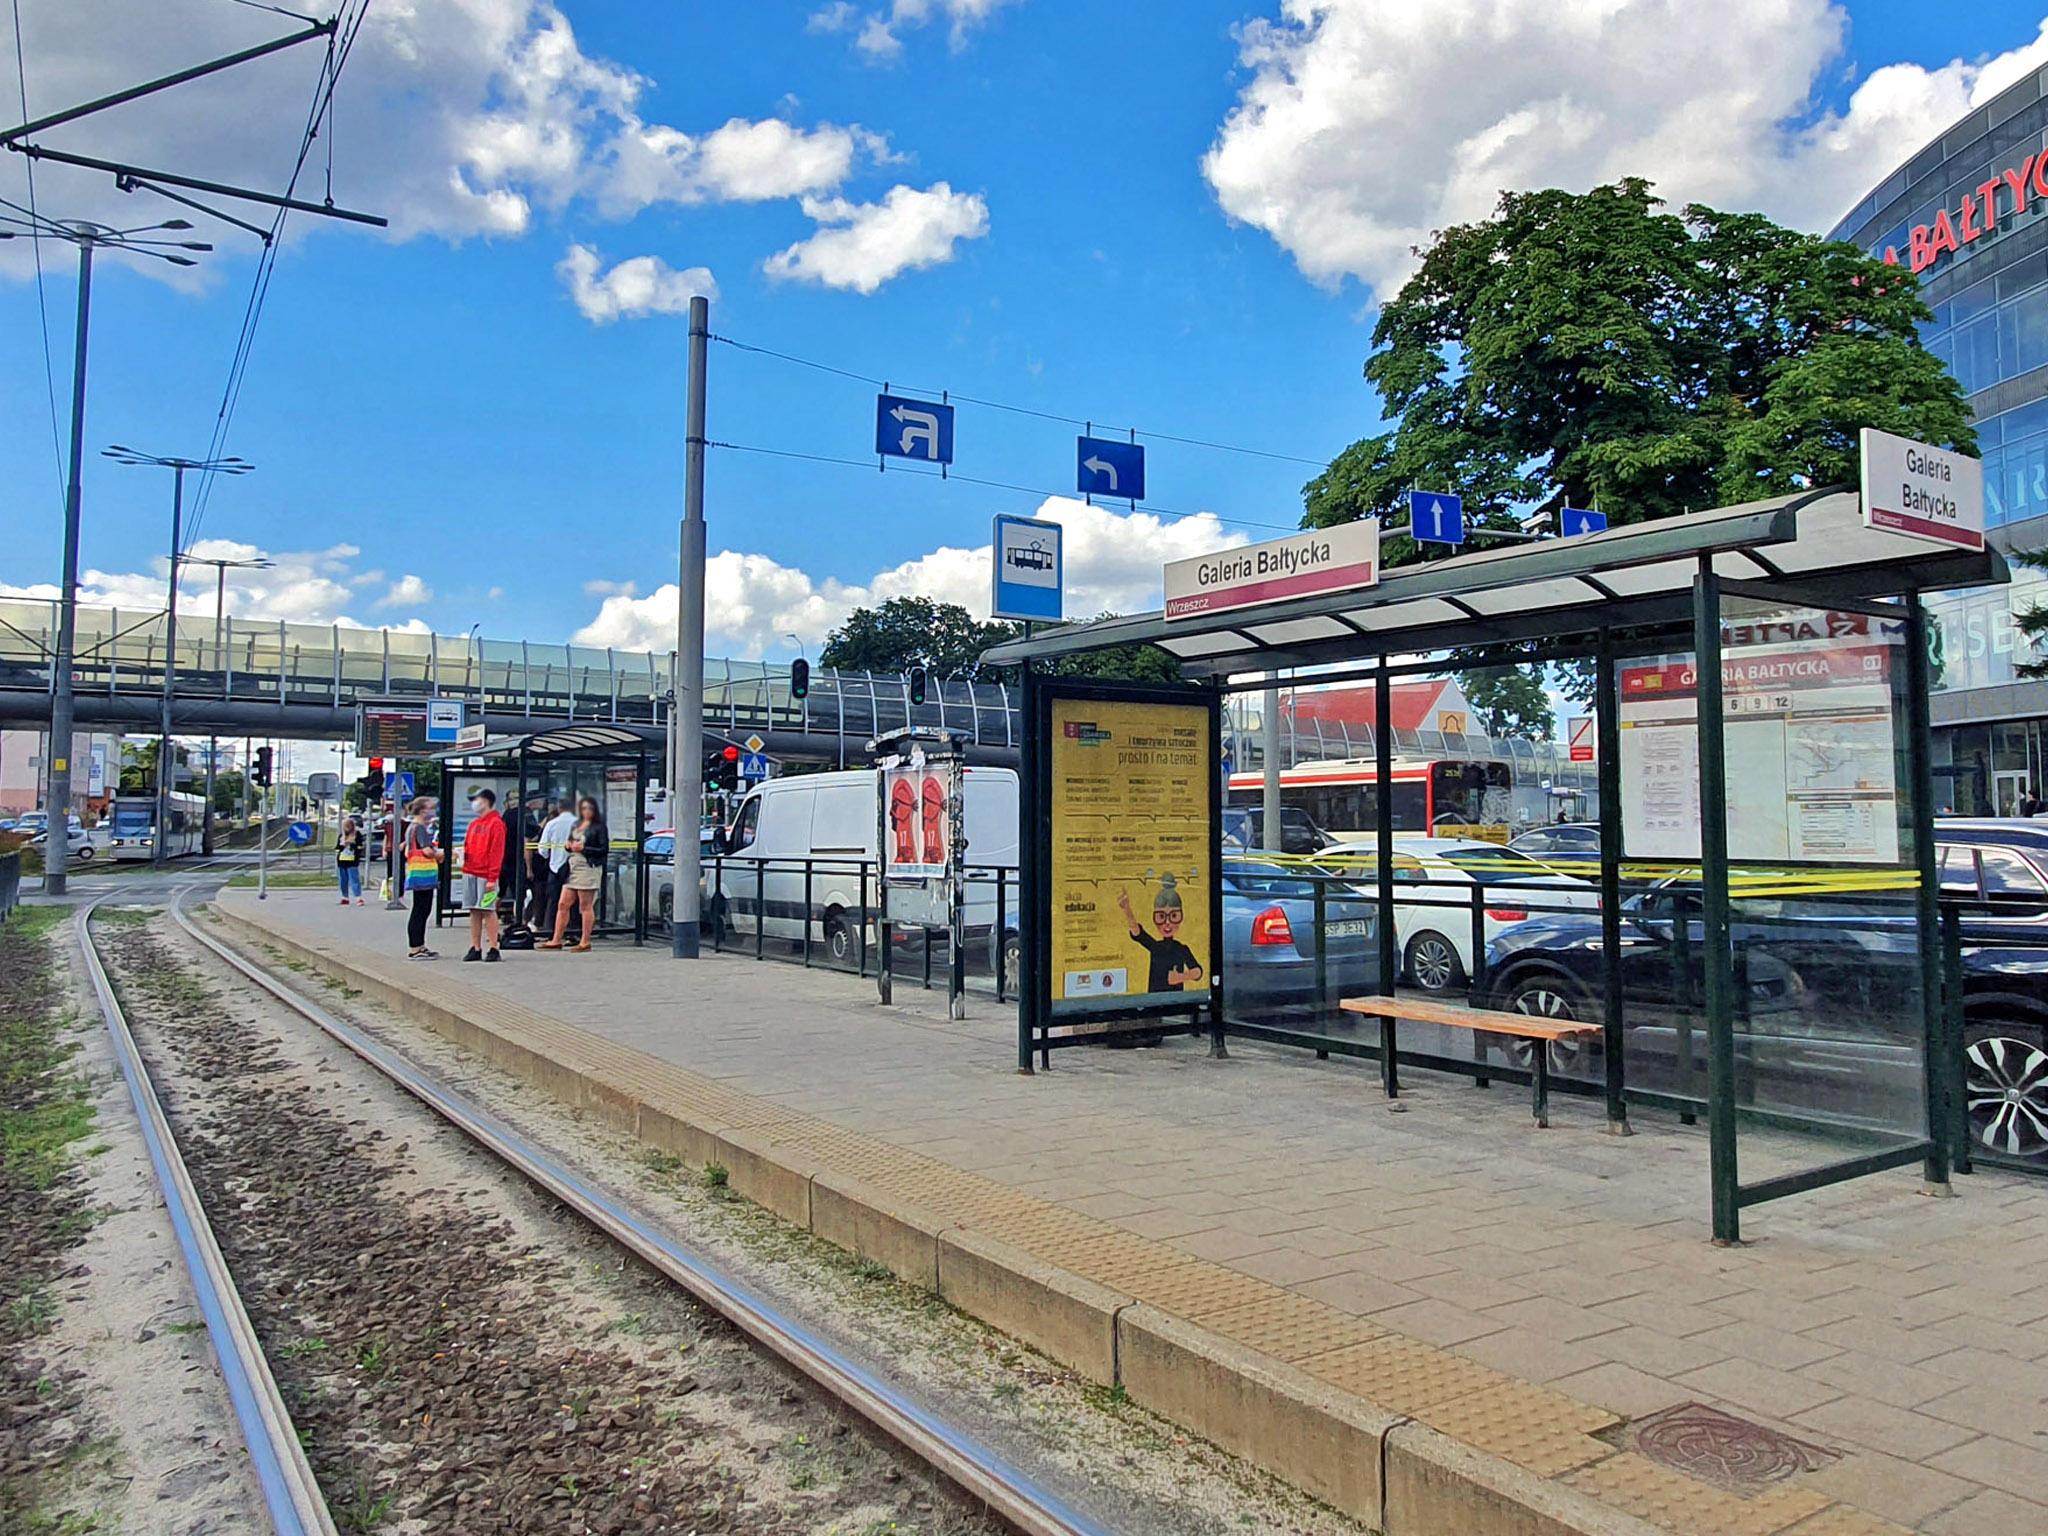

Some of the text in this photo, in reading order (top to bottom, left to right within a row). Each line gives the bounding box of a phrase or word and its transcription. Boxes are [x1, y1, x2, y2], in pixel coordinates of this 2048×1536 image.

[1906, 448, 1952, 482] Galeria
[1902, 483, 1957, 519] Bałtycka
[1197, 540, 1331, 586] Galeria Bałtycka
[1166, 596, 1210, 615] Wrzeszcz
[1748, 659, 1830, 680] BAŁTYCKA
[1730, 698, 1738, 710] 6
[1775, 695, 1789, 707] 12
[1118, 751, 1148, 766] prosto
[1157, 753, 1168, 765] na
[1171, 752, 1198, 766] temat
